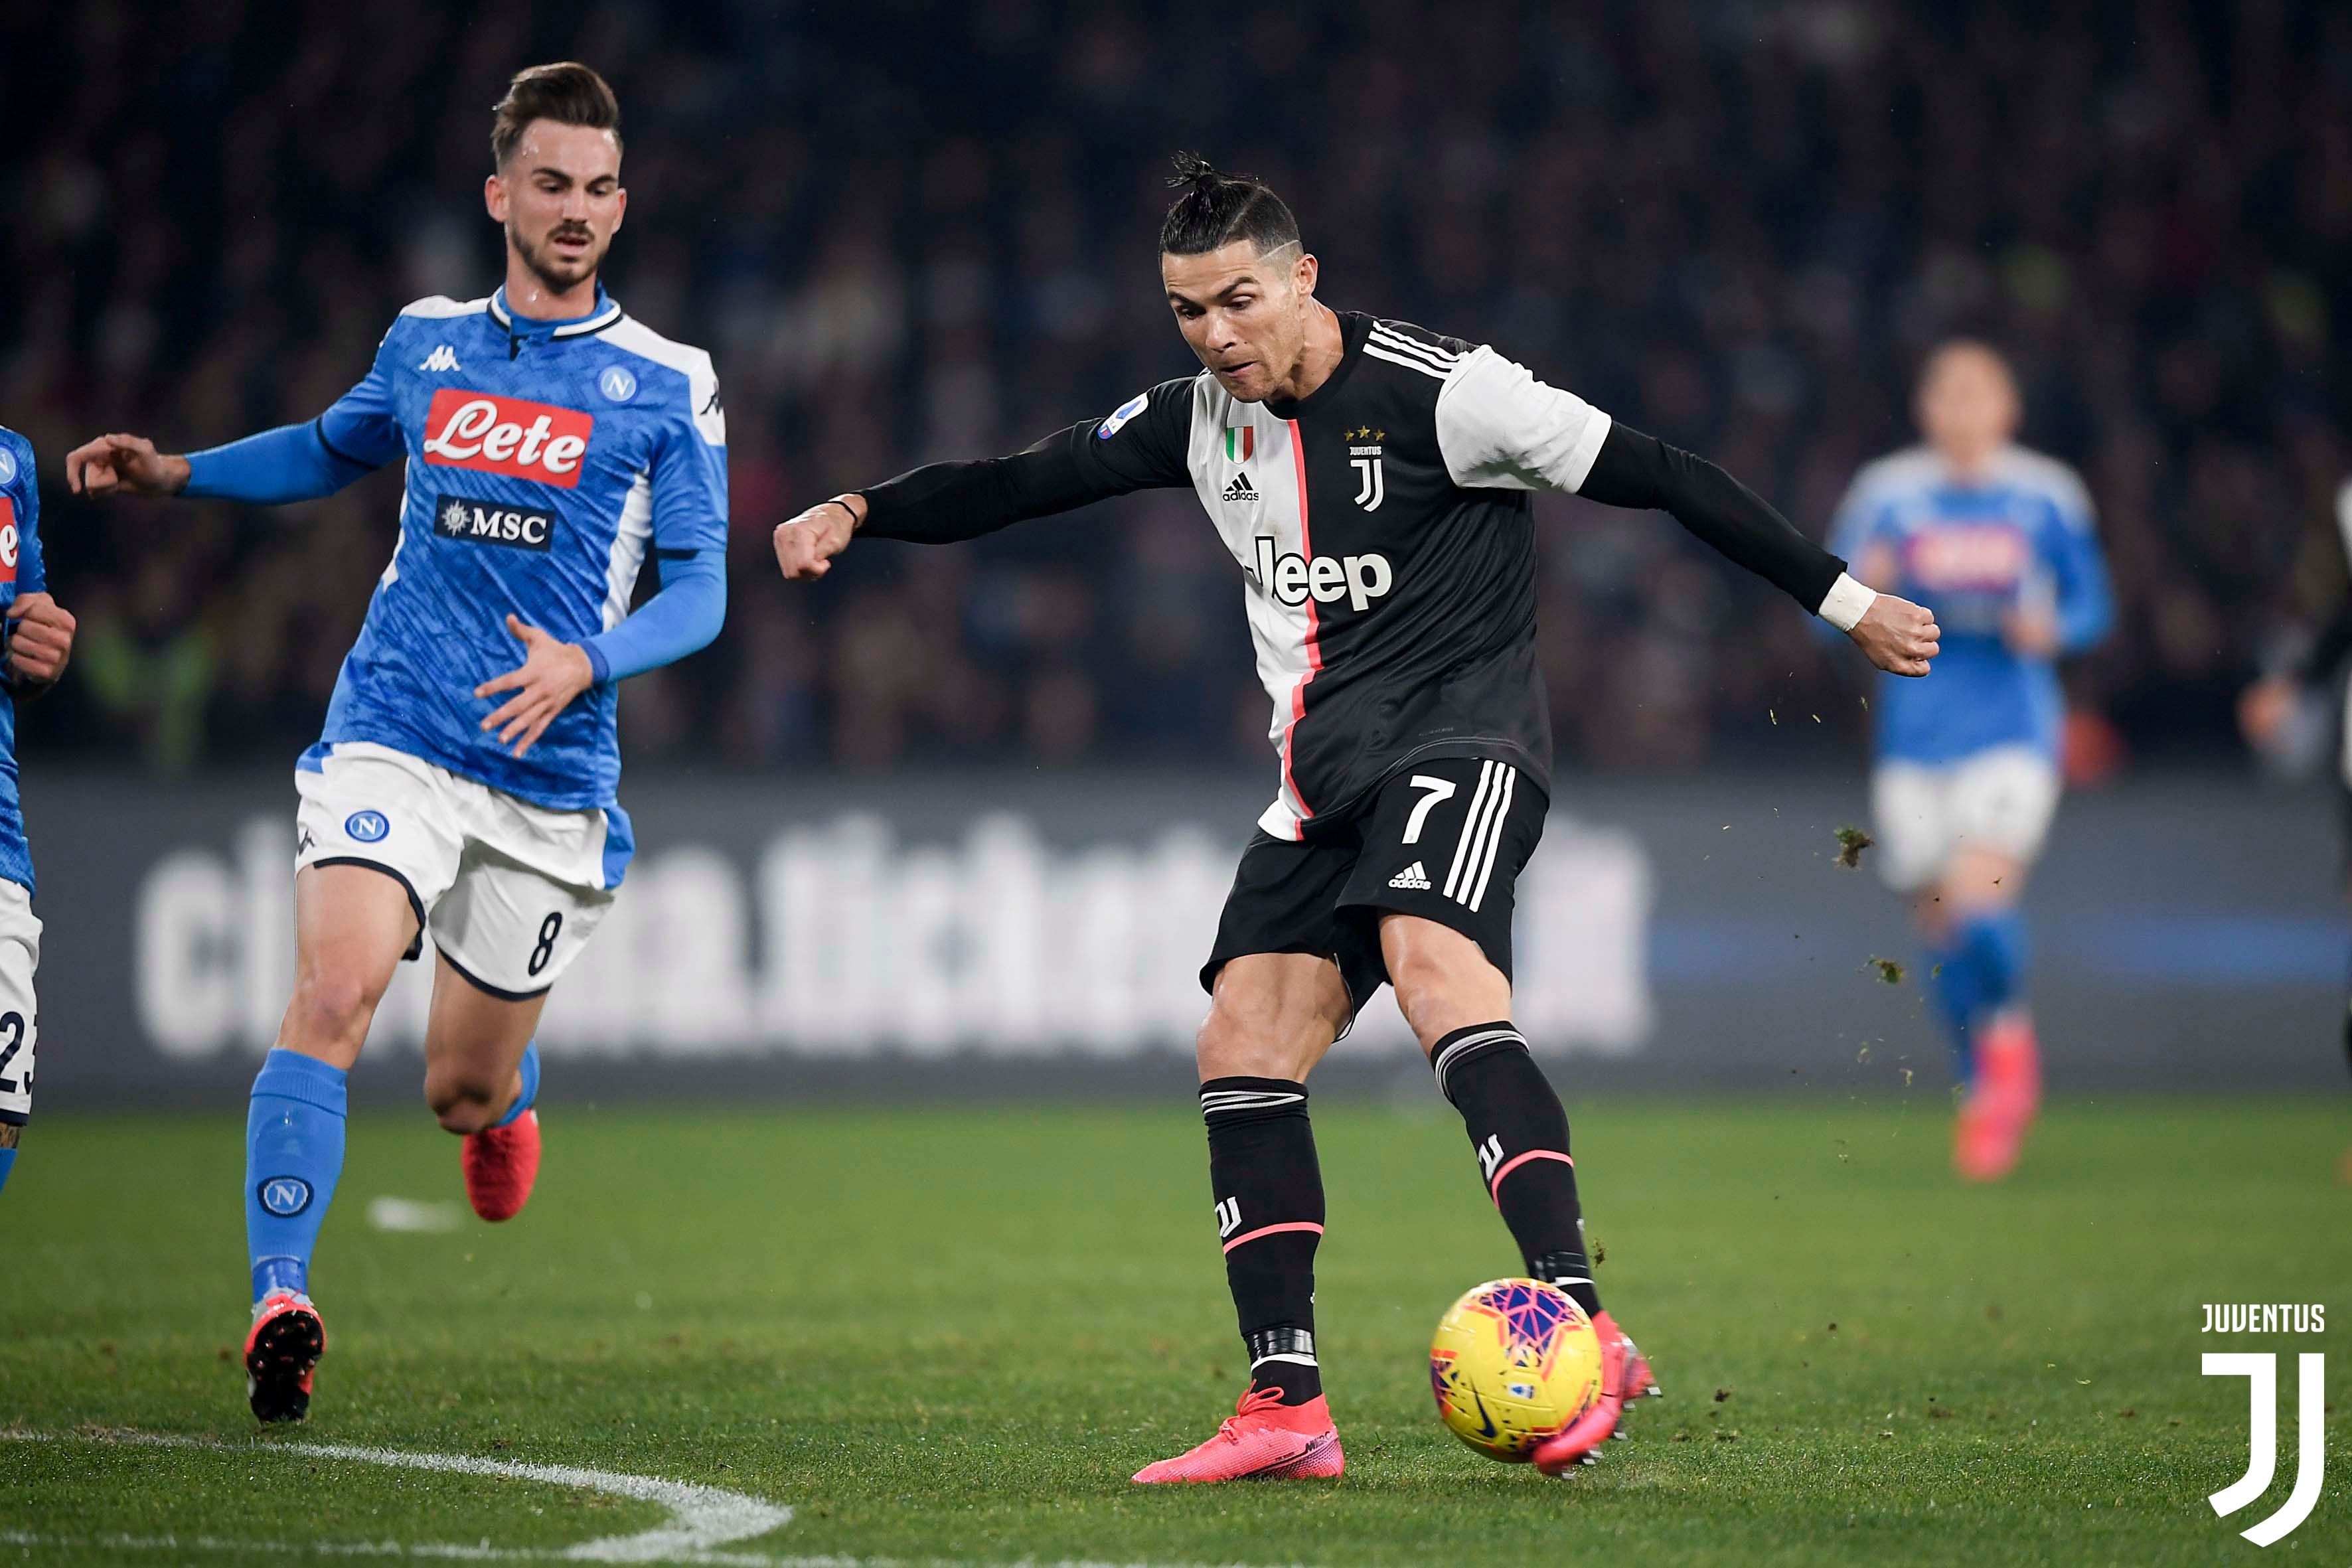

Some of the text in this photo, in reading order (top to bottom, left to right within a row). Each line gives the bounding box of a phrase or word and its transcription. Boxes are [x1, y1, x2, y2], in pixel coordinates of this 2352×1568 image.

[606, 374, 629, 396] N
[424, 400, 587, 474] Lete
[1349, 445, 1382, 456] JUVENTUS
[1222, 490, 1259, 502] adidas
[469, 507, 548, 544] MSC
[1244, 536, 1393, 612] Jeep
[1401, 775, 1456, 844] 7
[357, 817, 378, 834] N
[1388, 878, 1431, 890] adidas
[528, 911, 563, 977] 8
[274, 1184, 297, 1206] N
